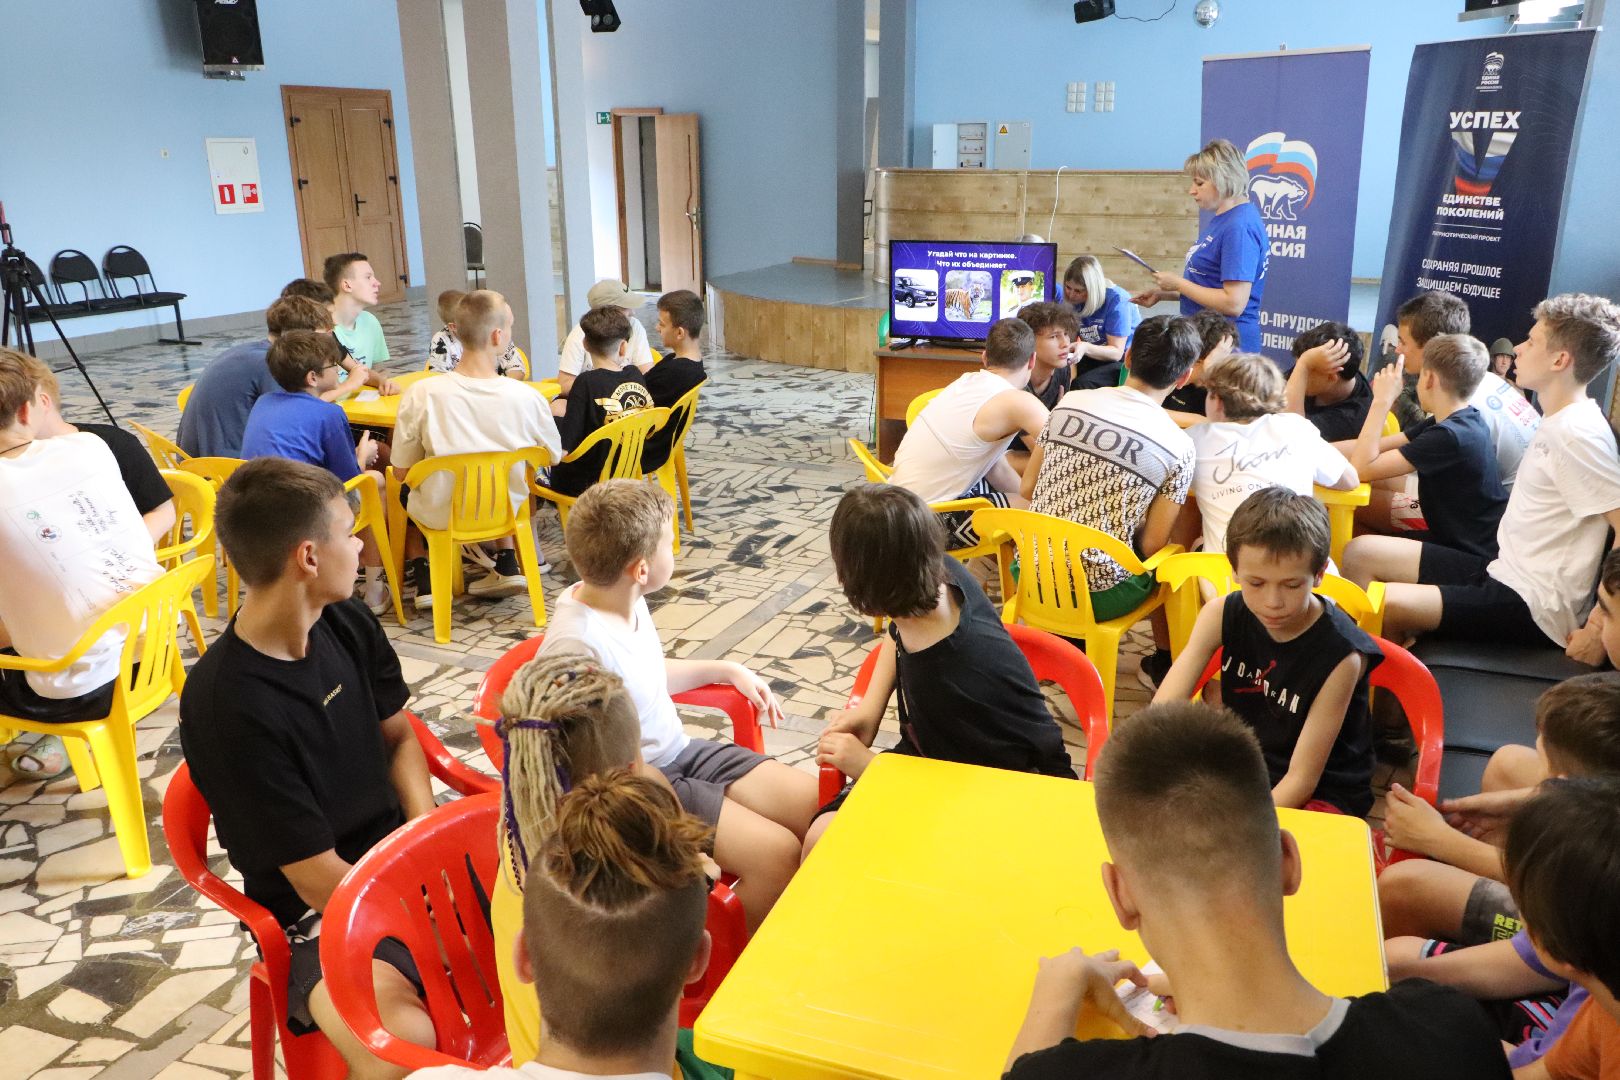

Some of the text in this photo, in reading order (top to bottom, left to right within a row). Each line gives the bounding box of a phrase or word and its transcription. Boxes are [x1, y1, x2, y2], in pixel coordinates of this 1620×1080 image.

[1449, 111, 1521, 129] УСПЕХ
[1443, 194, 1501, 206] ЕДИНСТВЕ
[1437, 206, 1504, 220] ПОКОЛЕНИЙ
[1270, 241, 1306, 258] СИЯ
[1461, 263, 1502, 278] ПРОШЛОЕ
[1463, 283, 1501, 299] БУДУЩЕЕ
[1057, 414, 1145, 466] DIOR
[1212, 485, 1243, 500] LIVING
